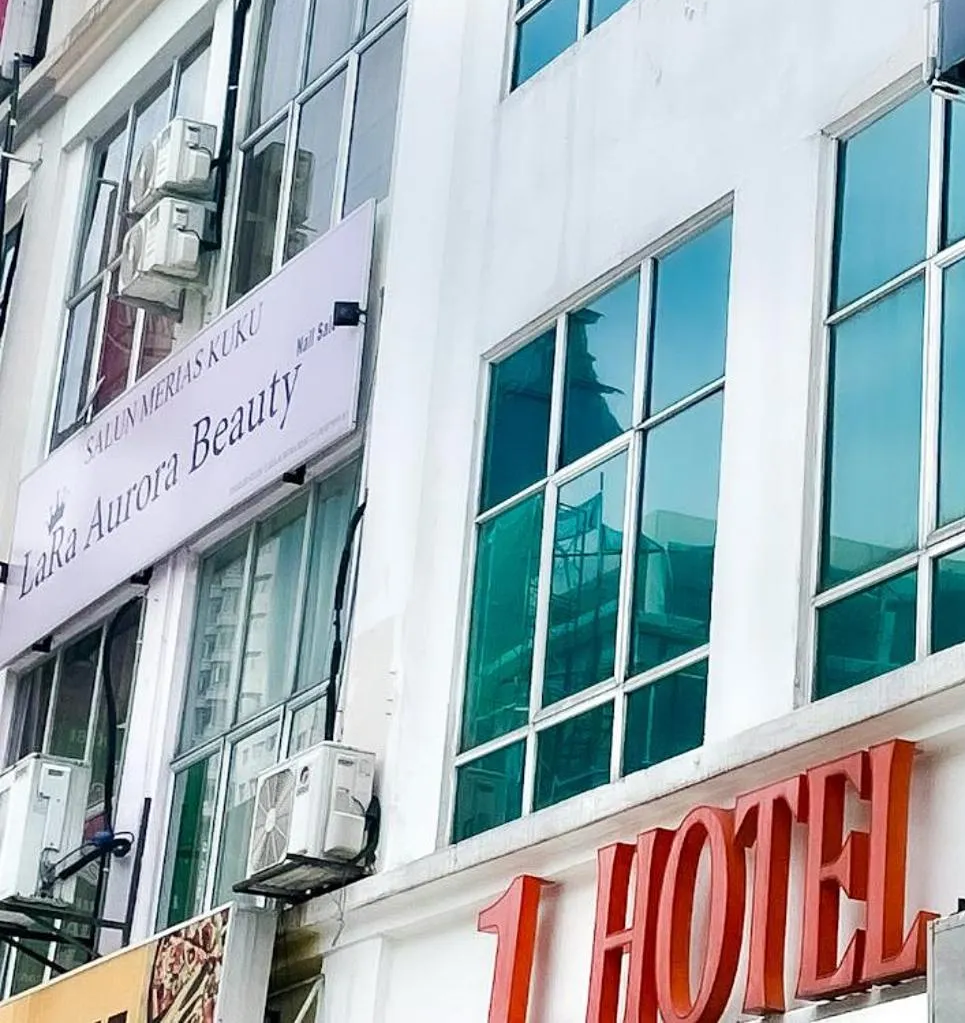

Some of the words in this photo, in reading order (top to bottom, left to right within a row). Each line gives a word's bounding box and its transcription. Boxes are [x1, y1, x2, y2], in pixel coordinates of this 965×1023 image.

[18, 525, 78, 600] LaRa
[85, 451, 179, 549] Aurora
[188, 364, 303, 475] Beauty
[84, 402, 136, 465] SALUN
[138, 347, 205, 423] MERIAS
[207, 301, 263, 369] KUKU
[478, 875, 553, 1023] 1
[586, 739, 939, 1023] HOTEL
